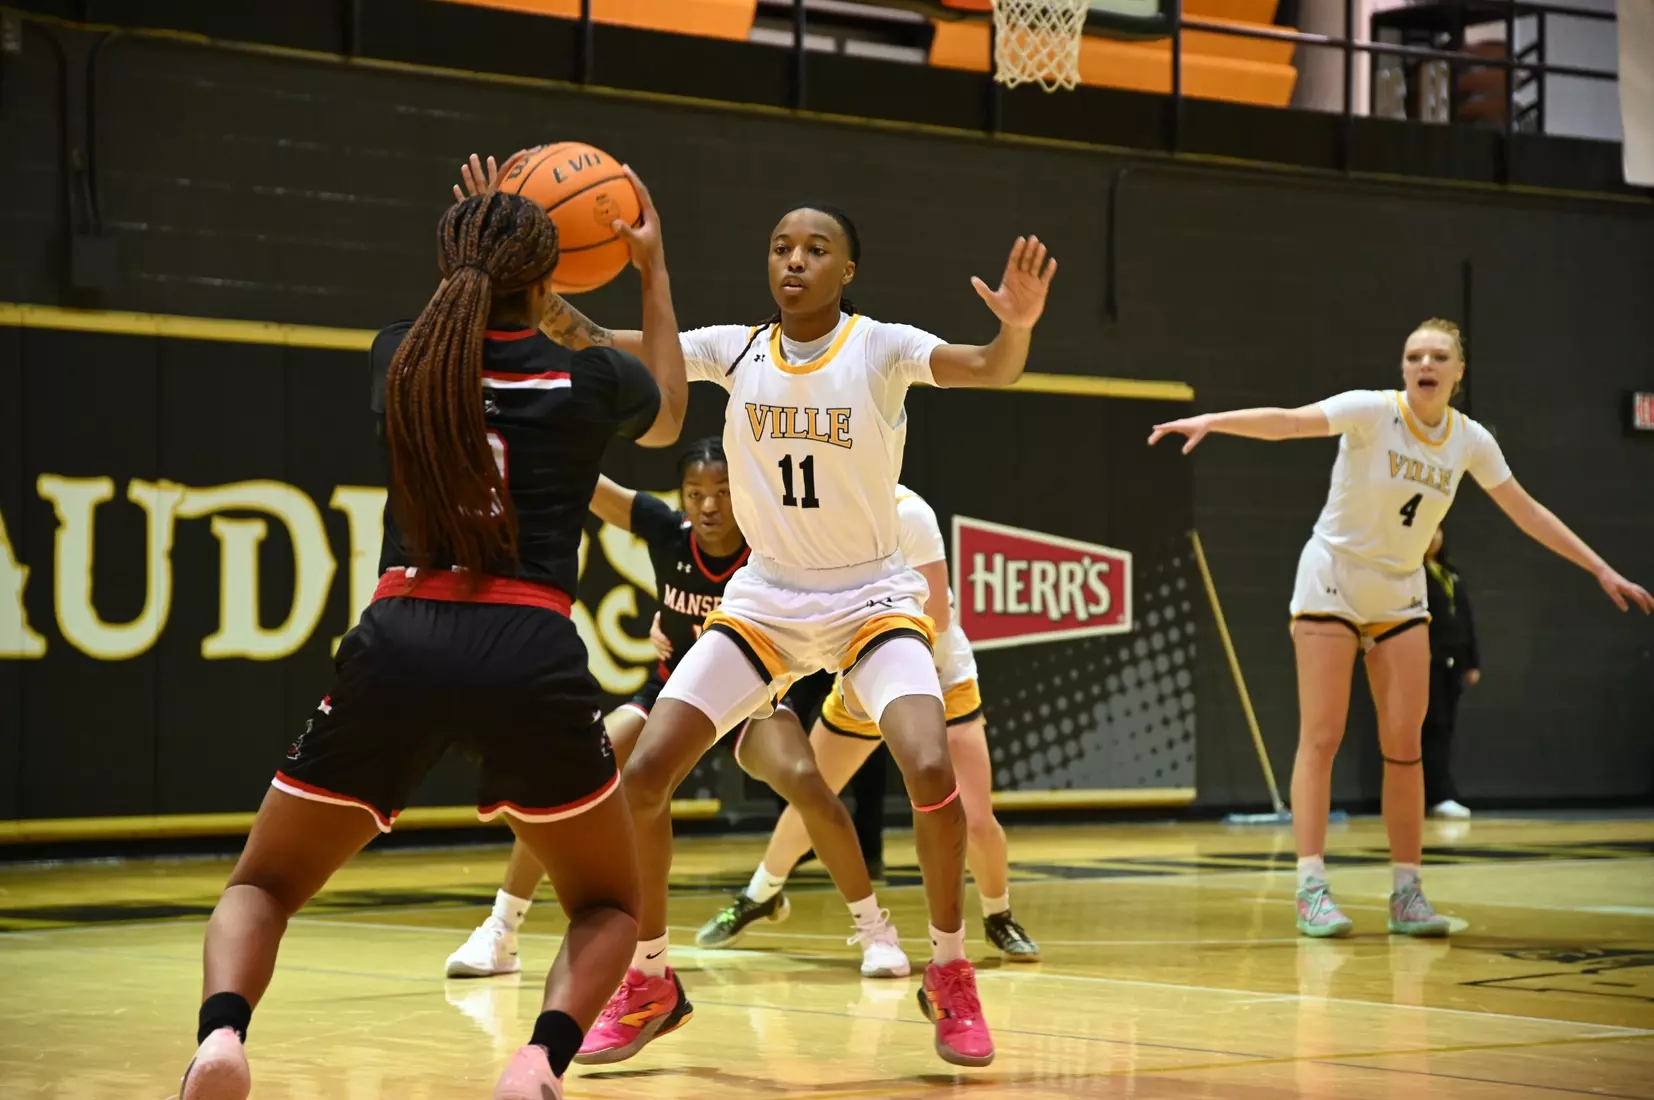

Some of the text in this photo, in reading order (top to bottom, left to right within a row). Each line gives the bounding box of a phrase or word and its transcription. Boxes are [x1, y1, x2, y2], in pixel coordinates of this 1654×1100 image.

[745, 402, 853, 449] VILLE
[778, 454, 820, 508] 11
[1388, 449, 1453, 497] VILLE
[1399, 492, 1423, 527] 4
[967, 552, 1111, 621] HERR'S
